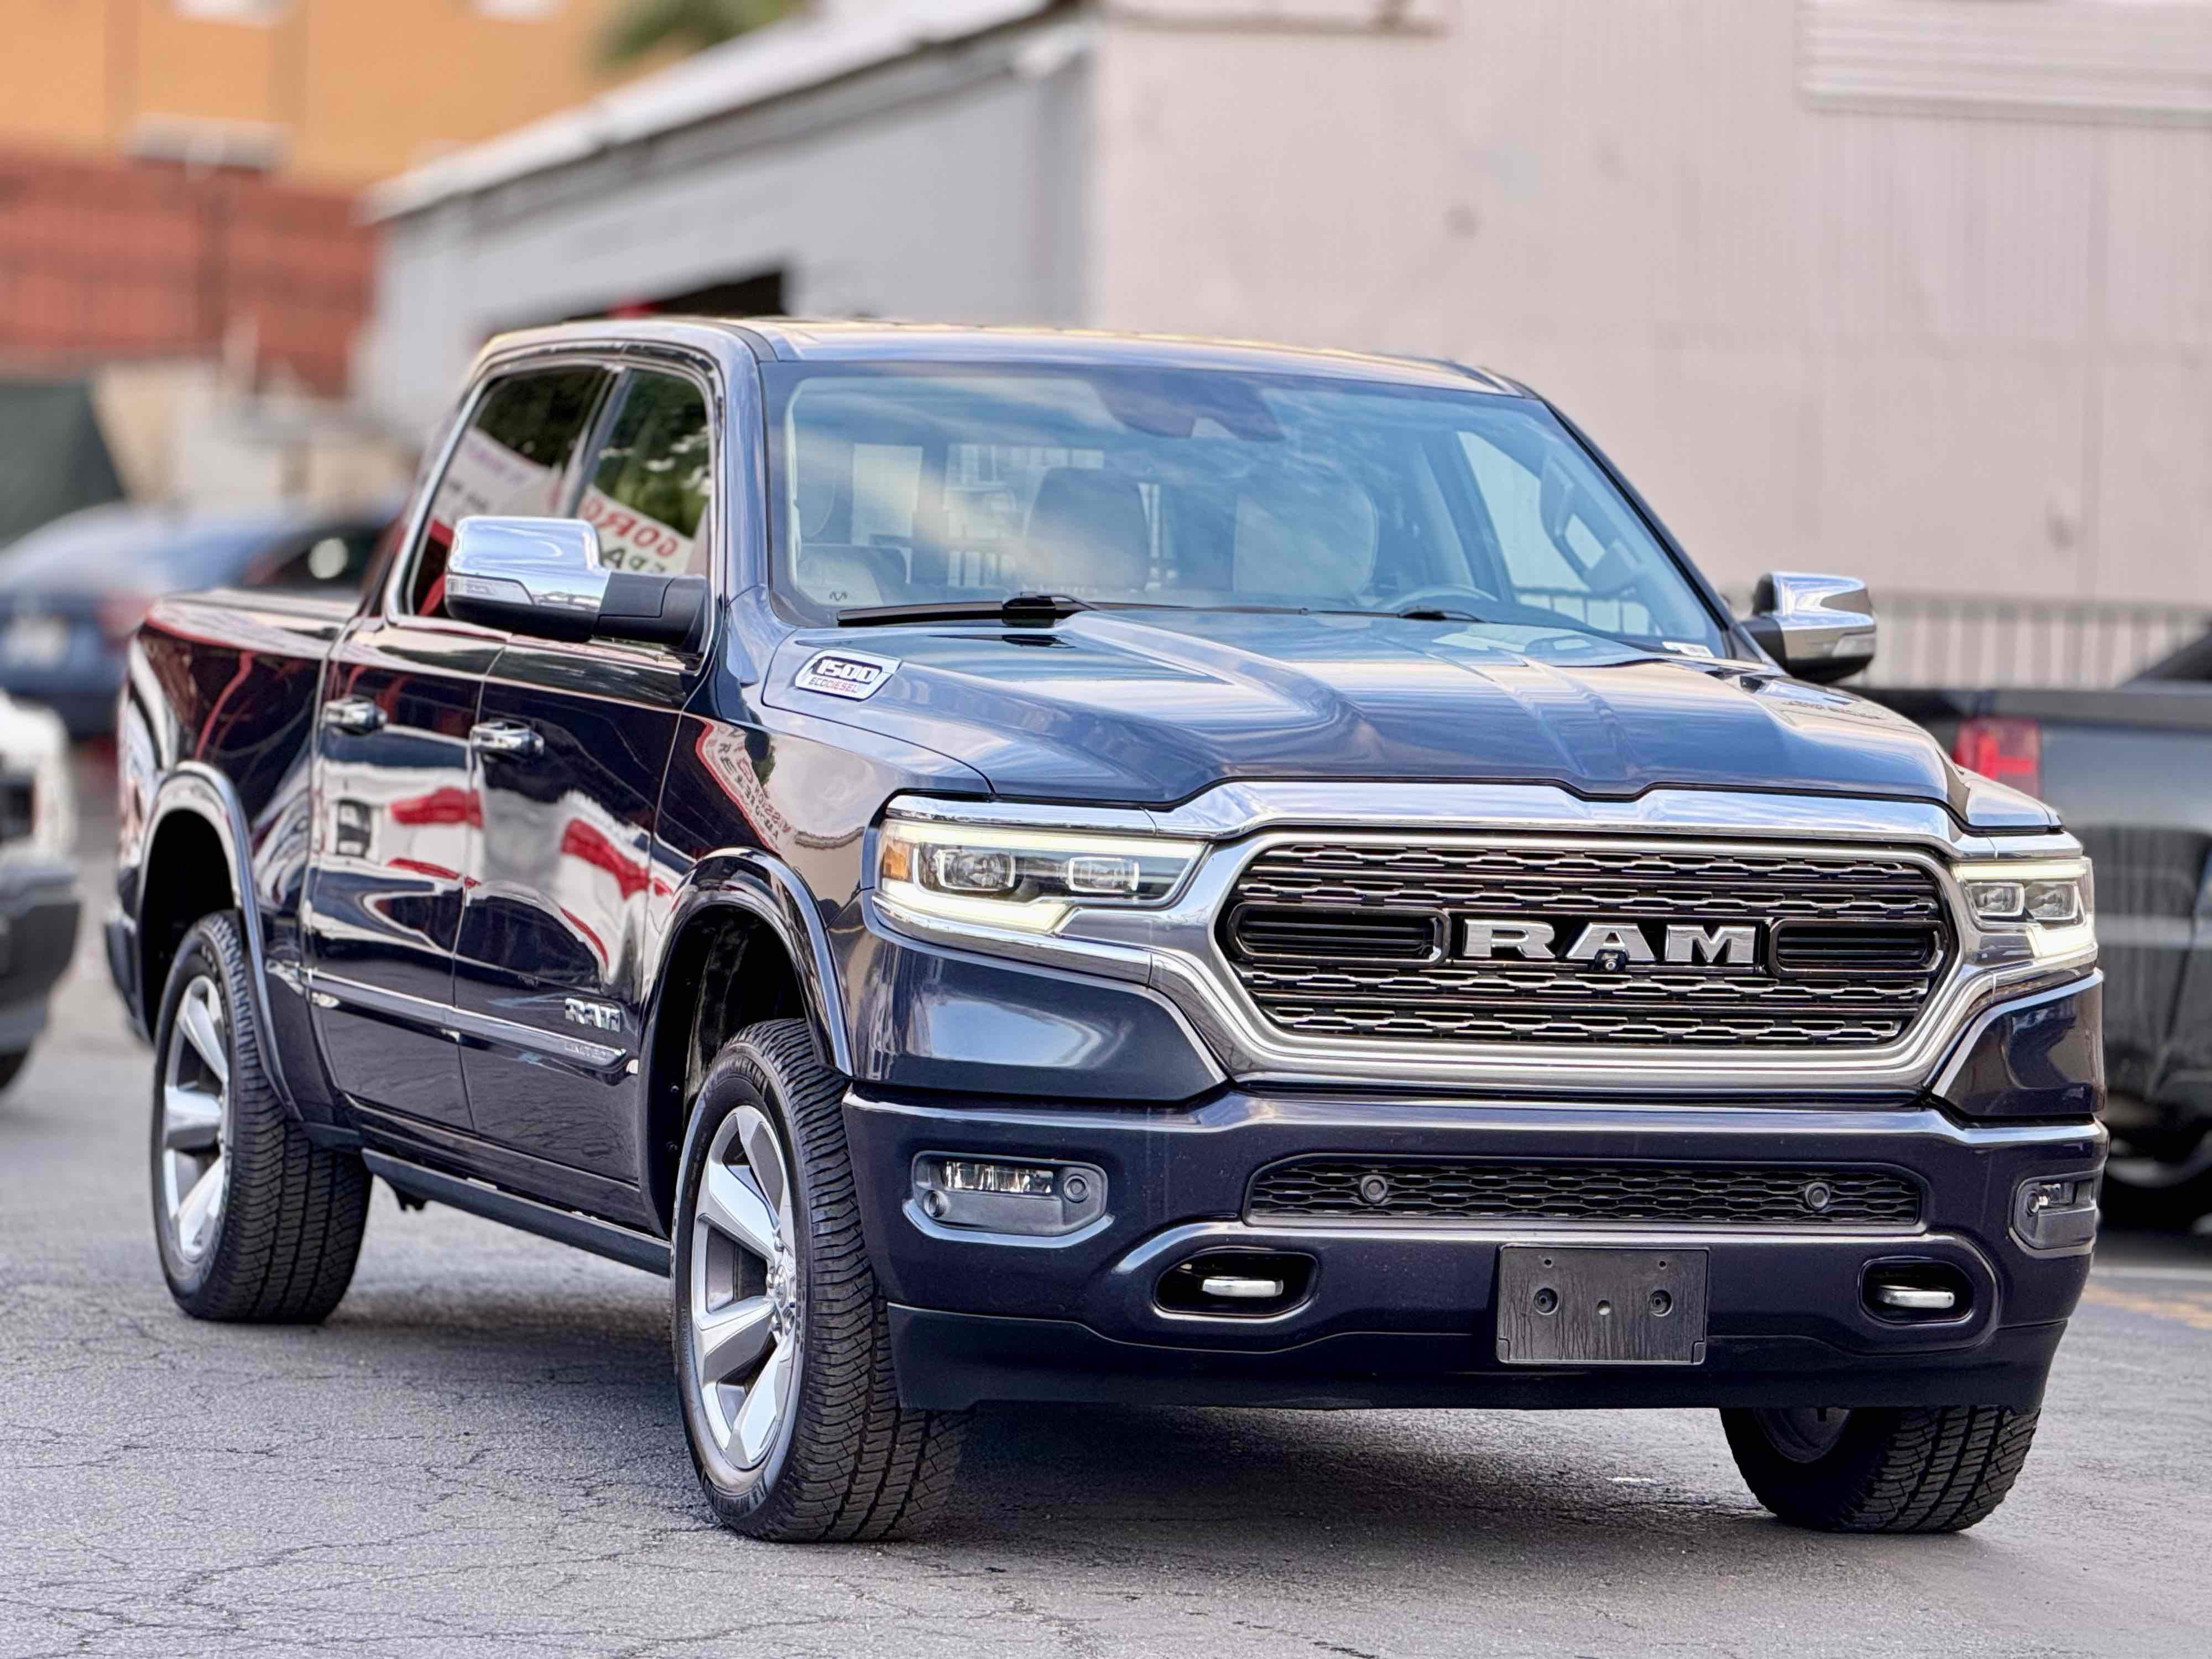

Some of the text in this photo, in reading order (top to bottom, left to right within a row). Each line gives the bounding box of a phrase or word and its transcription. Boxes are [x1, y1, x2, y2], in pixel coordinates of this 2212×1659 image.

[809, 676, 858, 692] ECODIESEL
[817, 658, 881, 684] 1500
[1463, 918, 1756, 964] RAM
[565, 998, 620, 1032] RAM
